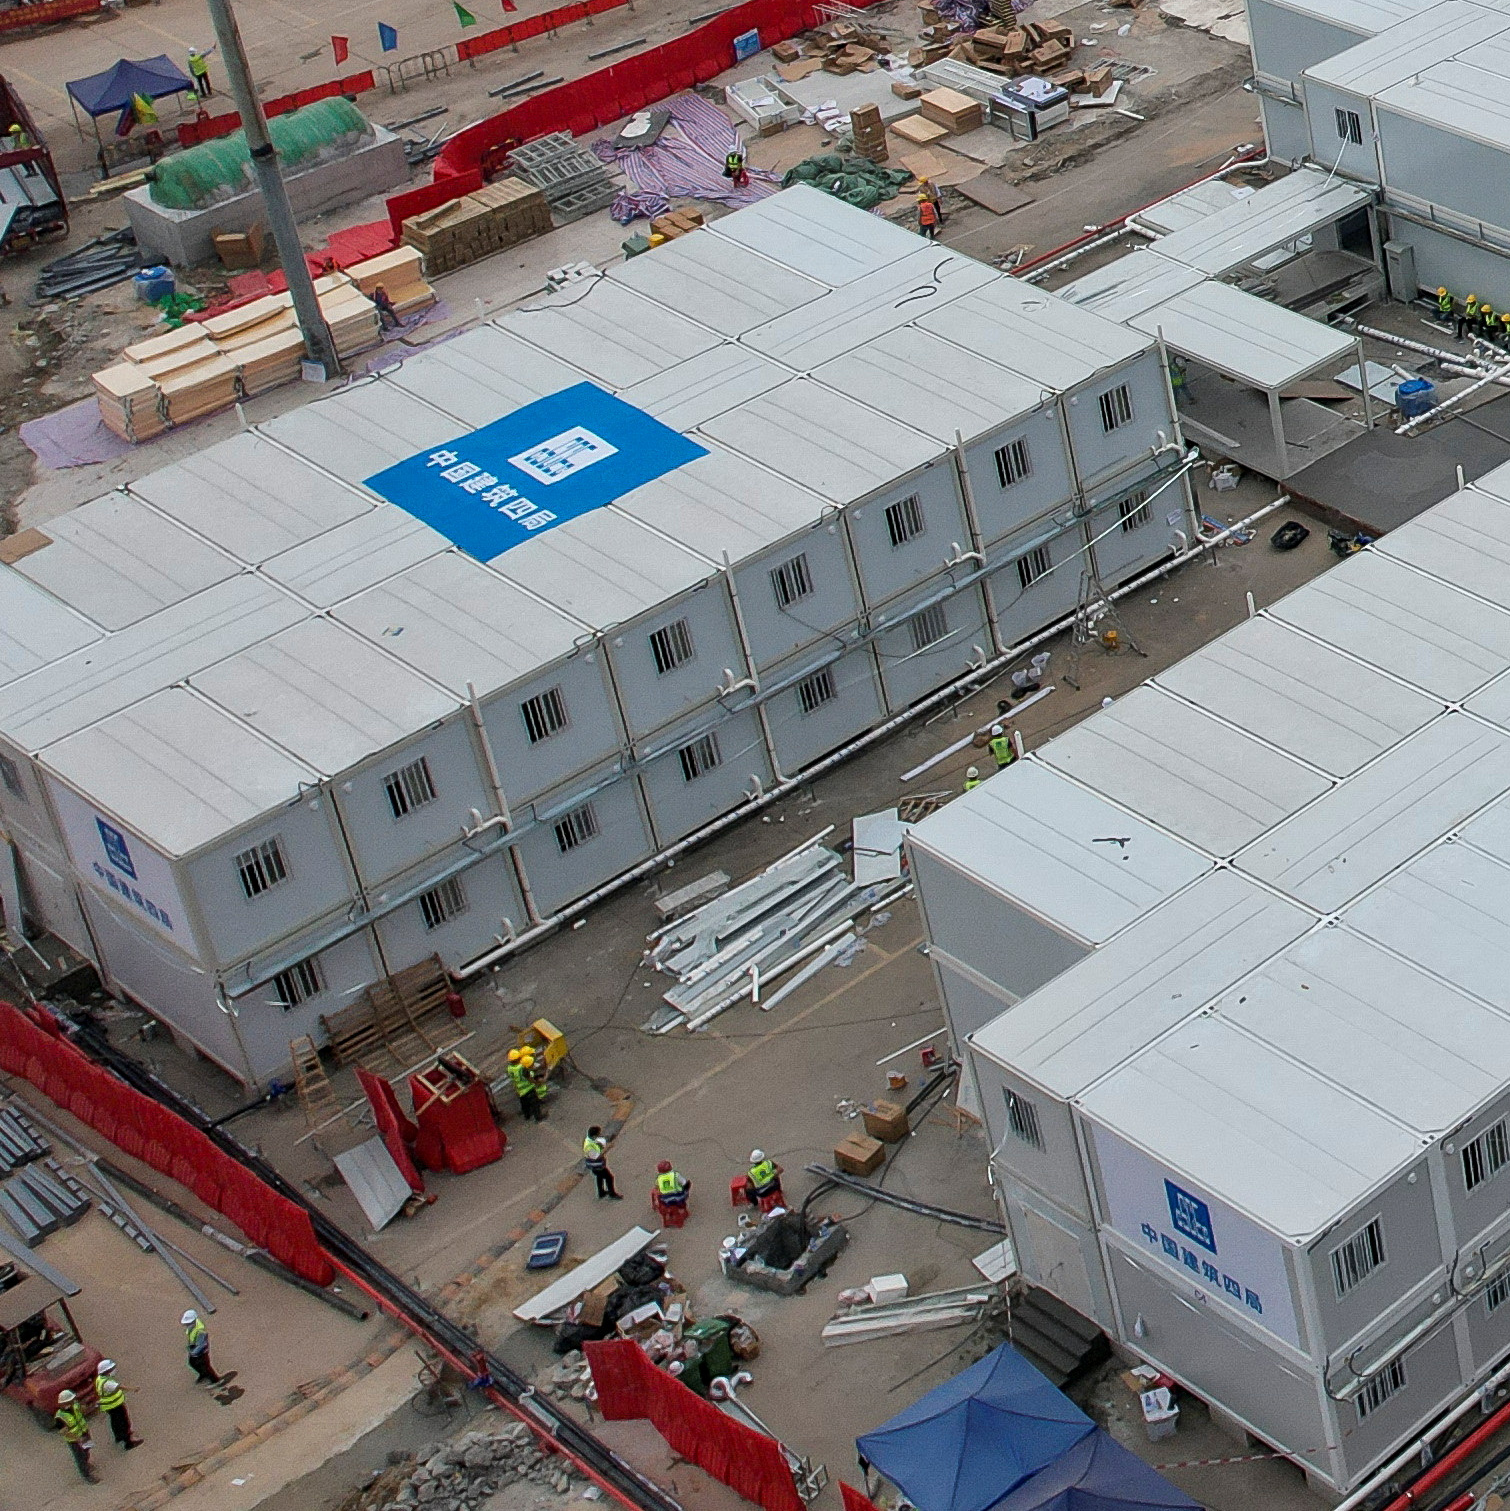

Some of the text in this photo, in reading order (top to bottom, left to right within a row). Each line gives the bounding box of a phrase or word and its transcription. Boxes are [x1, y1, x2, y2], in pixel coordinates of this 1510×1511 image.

[426, 449, 558, 531] 中国建筑四局
[1141, 1223, 1262, 1314] 中国建筑四局
